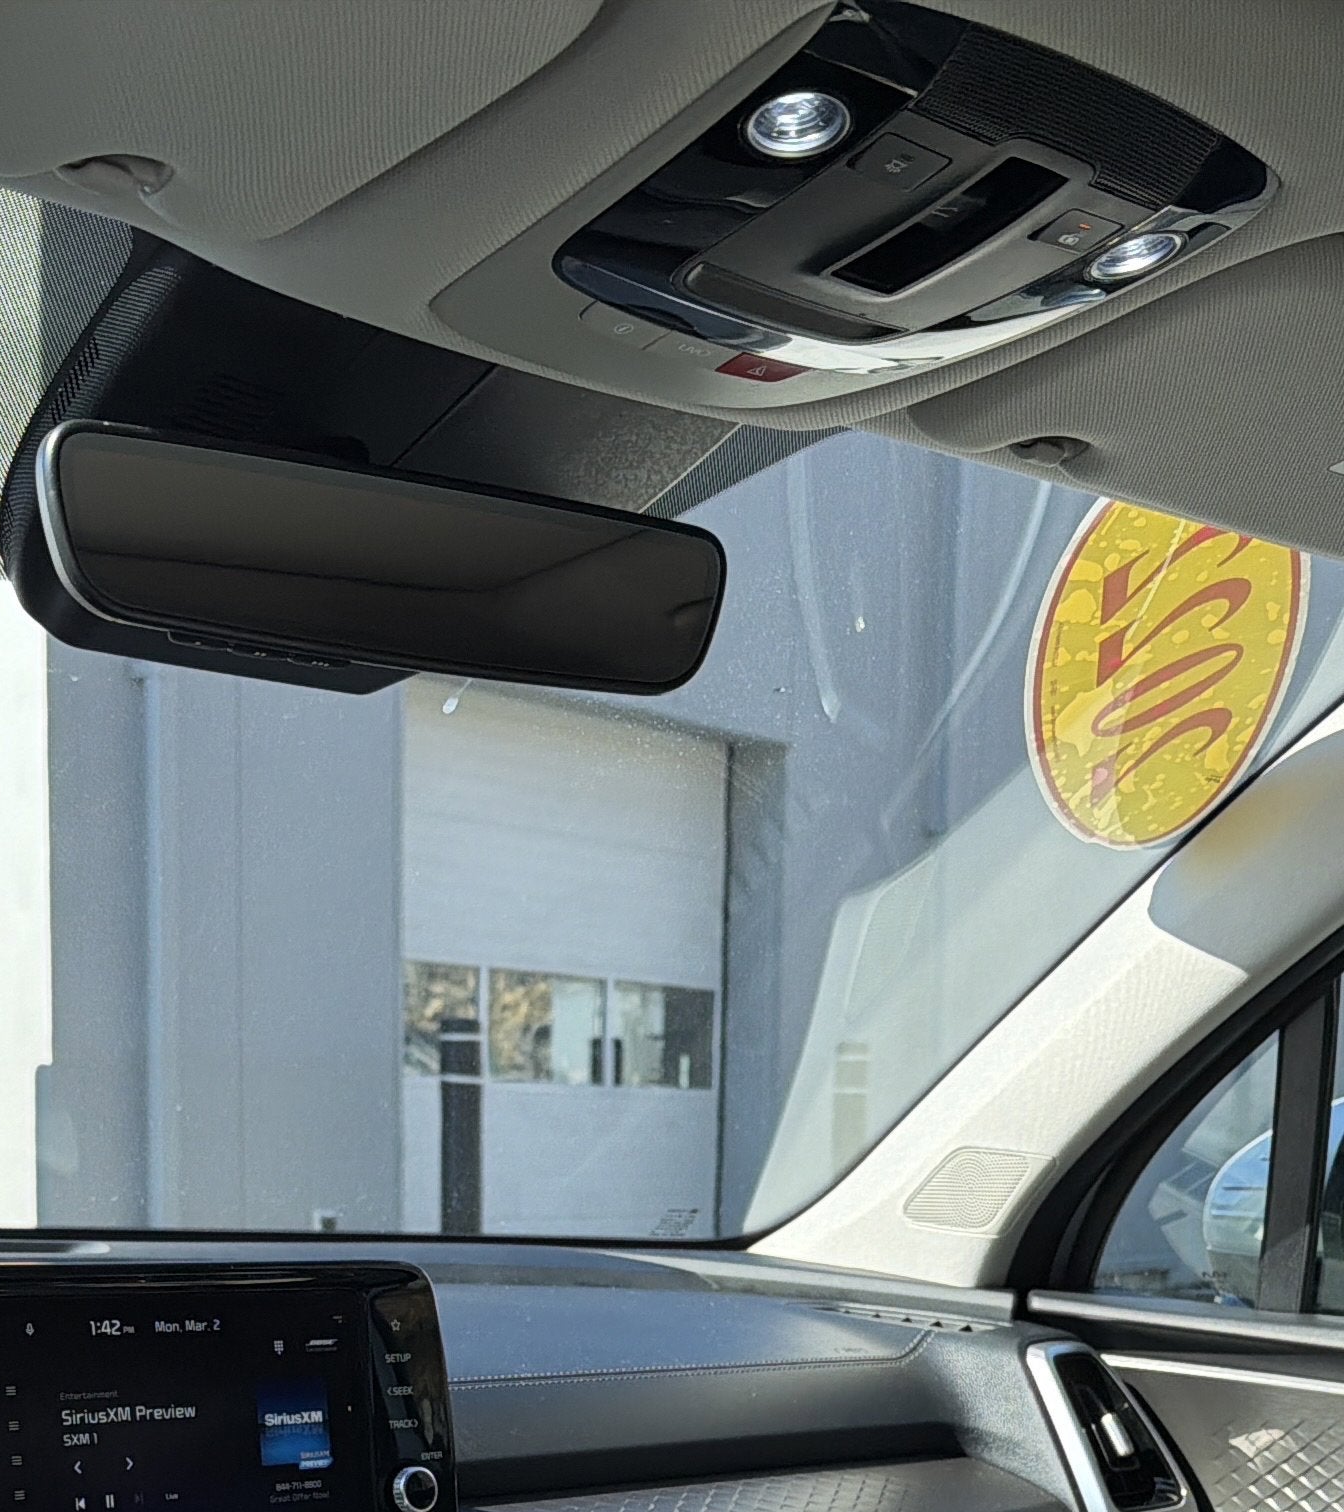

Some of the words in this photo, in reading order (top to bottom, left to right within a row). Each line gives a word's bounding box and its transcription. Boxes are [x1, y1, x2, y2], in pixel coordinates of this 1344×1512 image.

[89, 1320, 122, 1336] 1:42
[122, 1326, 136, 1334] PM
[185, 1319, 211, 1332] Mar.
[212, 1319, 221, 1331] 2
[384, 1353, 412, 1364] SETUP
[61, 1406, 132, 1427] SiriusXM
[135, 1403, 197, 1422] Preview
[264, 1410, 324, 1427] SiriusXM
[62, 1433, 90, 1447] SXM
[92, 1432, 99, 1445] 1
[420, 1451, 444, 1461] ENTER
